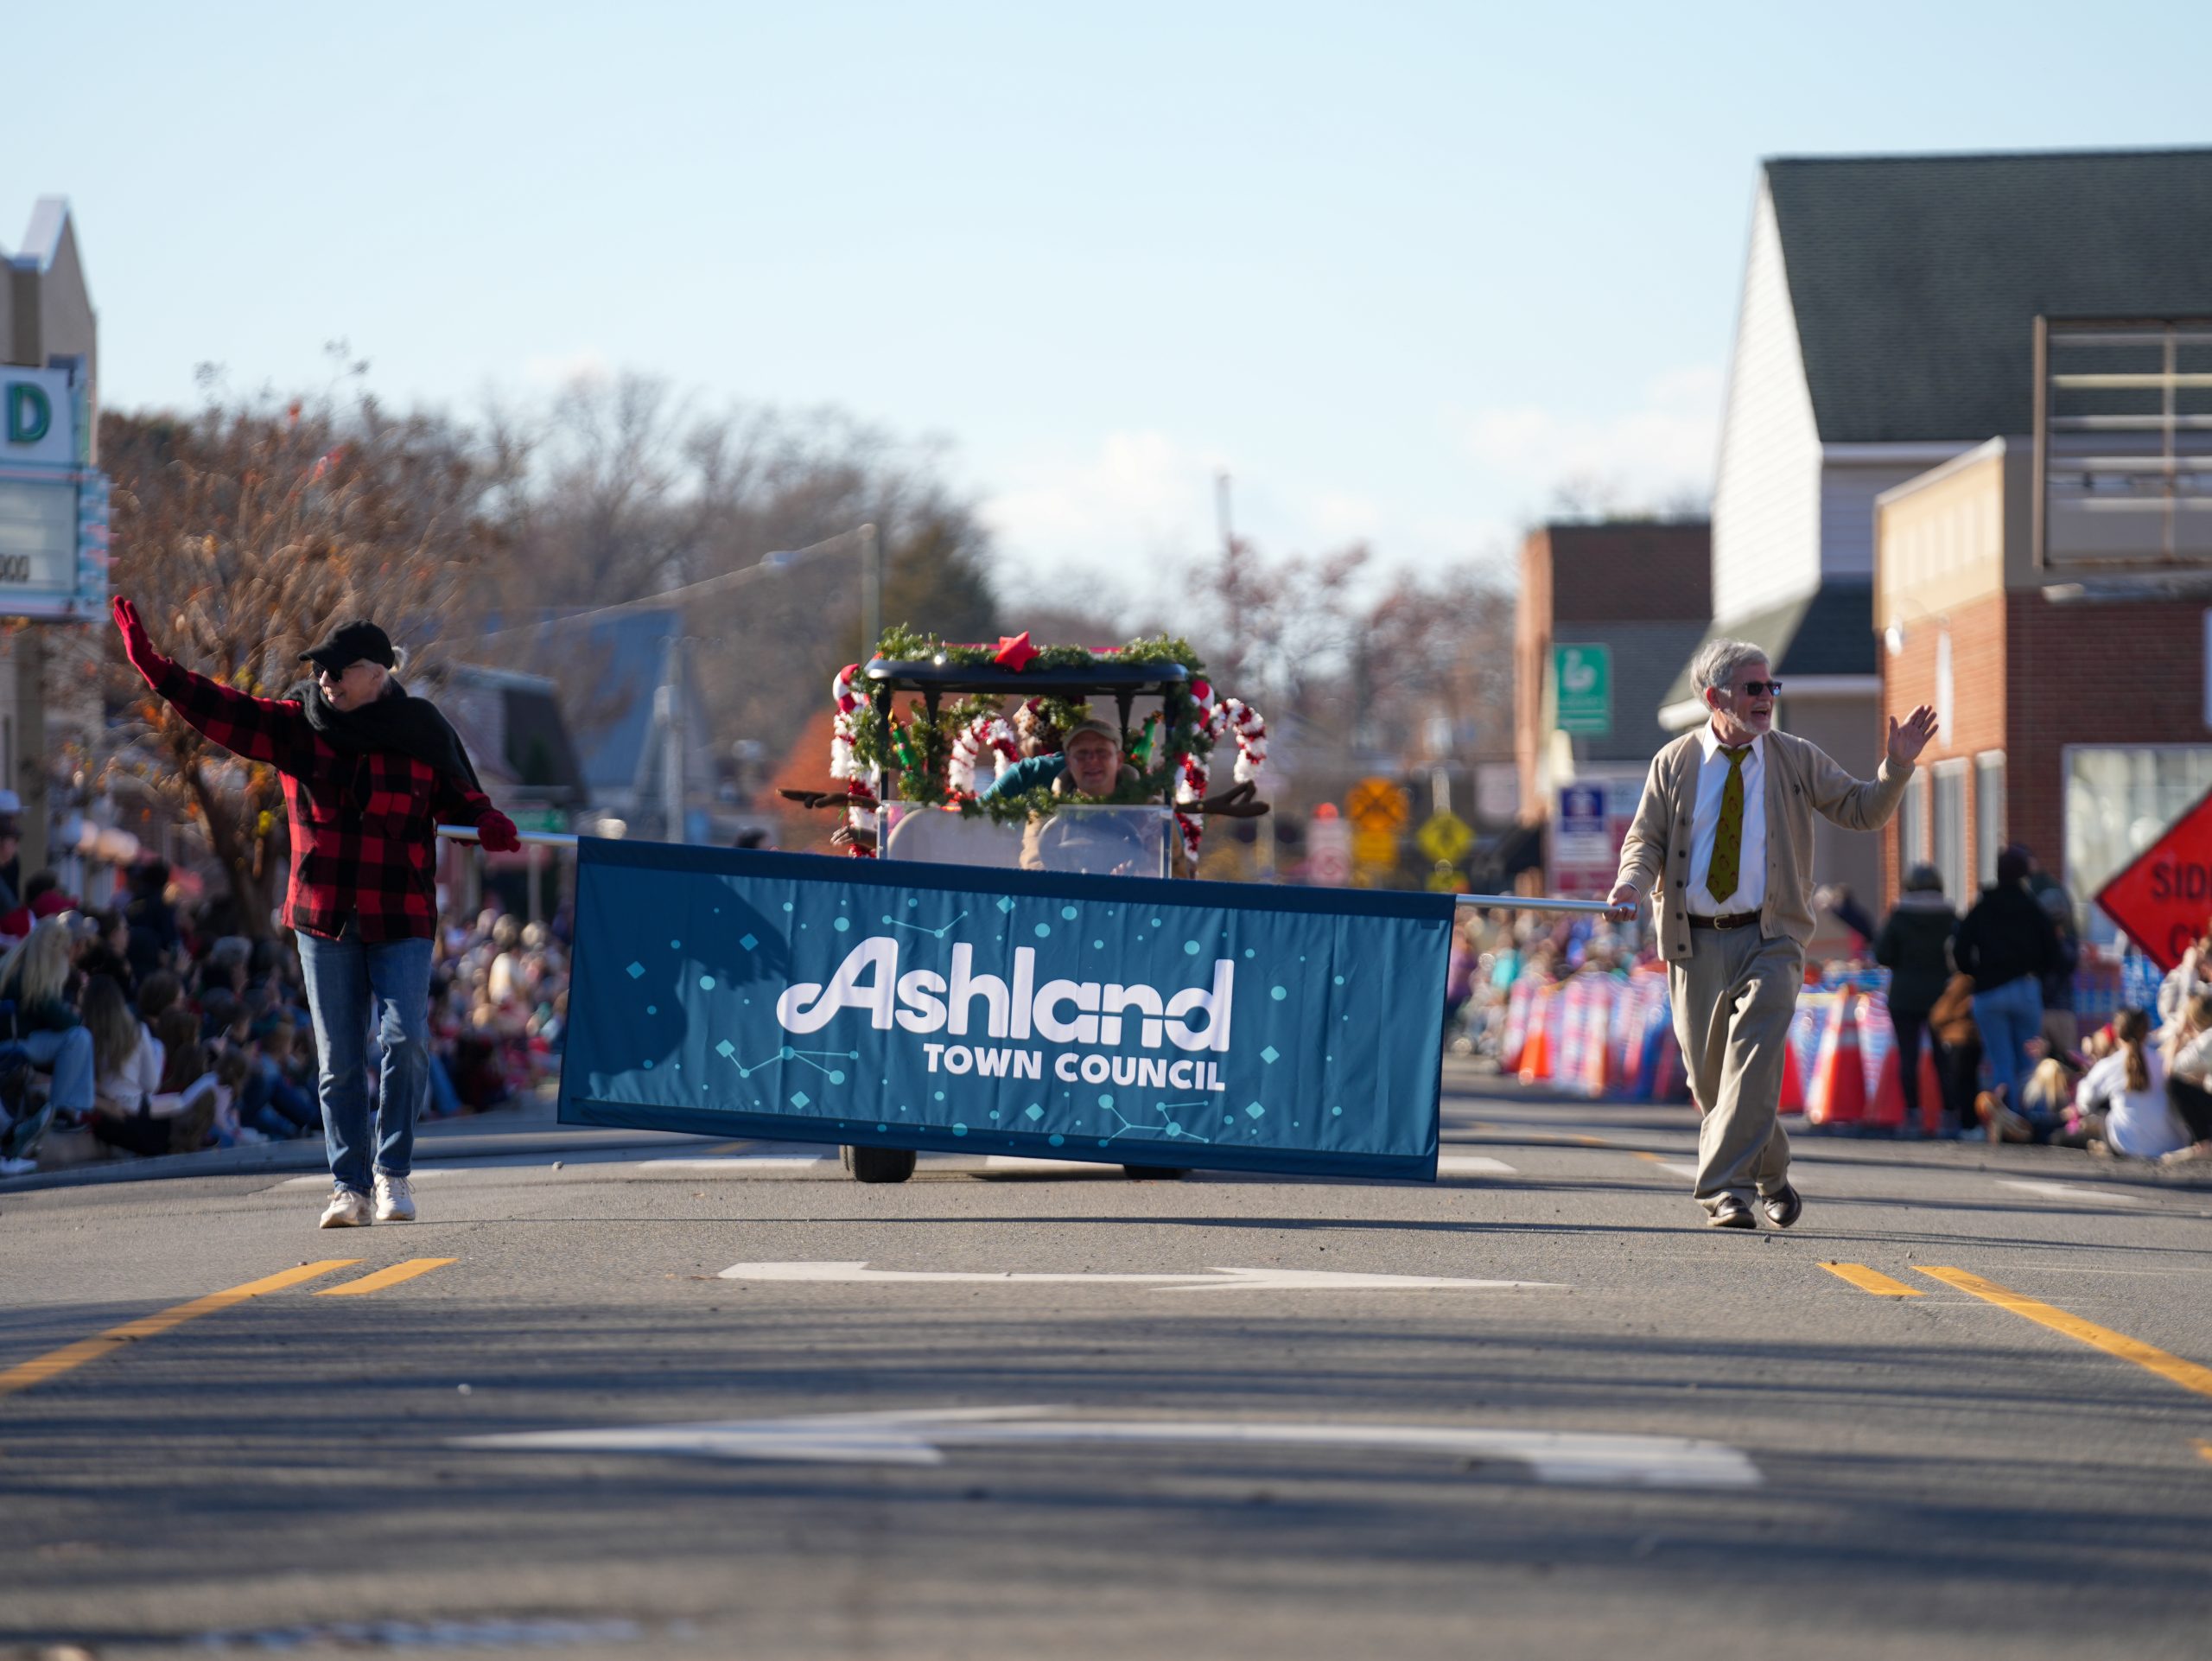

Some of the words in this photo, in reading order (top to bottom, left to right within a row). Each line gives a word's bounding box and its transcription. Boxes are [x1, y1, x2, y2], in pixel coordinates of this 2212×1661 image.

[7, 380, 52, 442] D
[2152, 862, 2212, 900] SID
[776, 936, 1235, 1053] Ashland
[923, 1043, 1043, 1079] TOWN
[1054, 1053, 1225, 1091] COUNCIL
